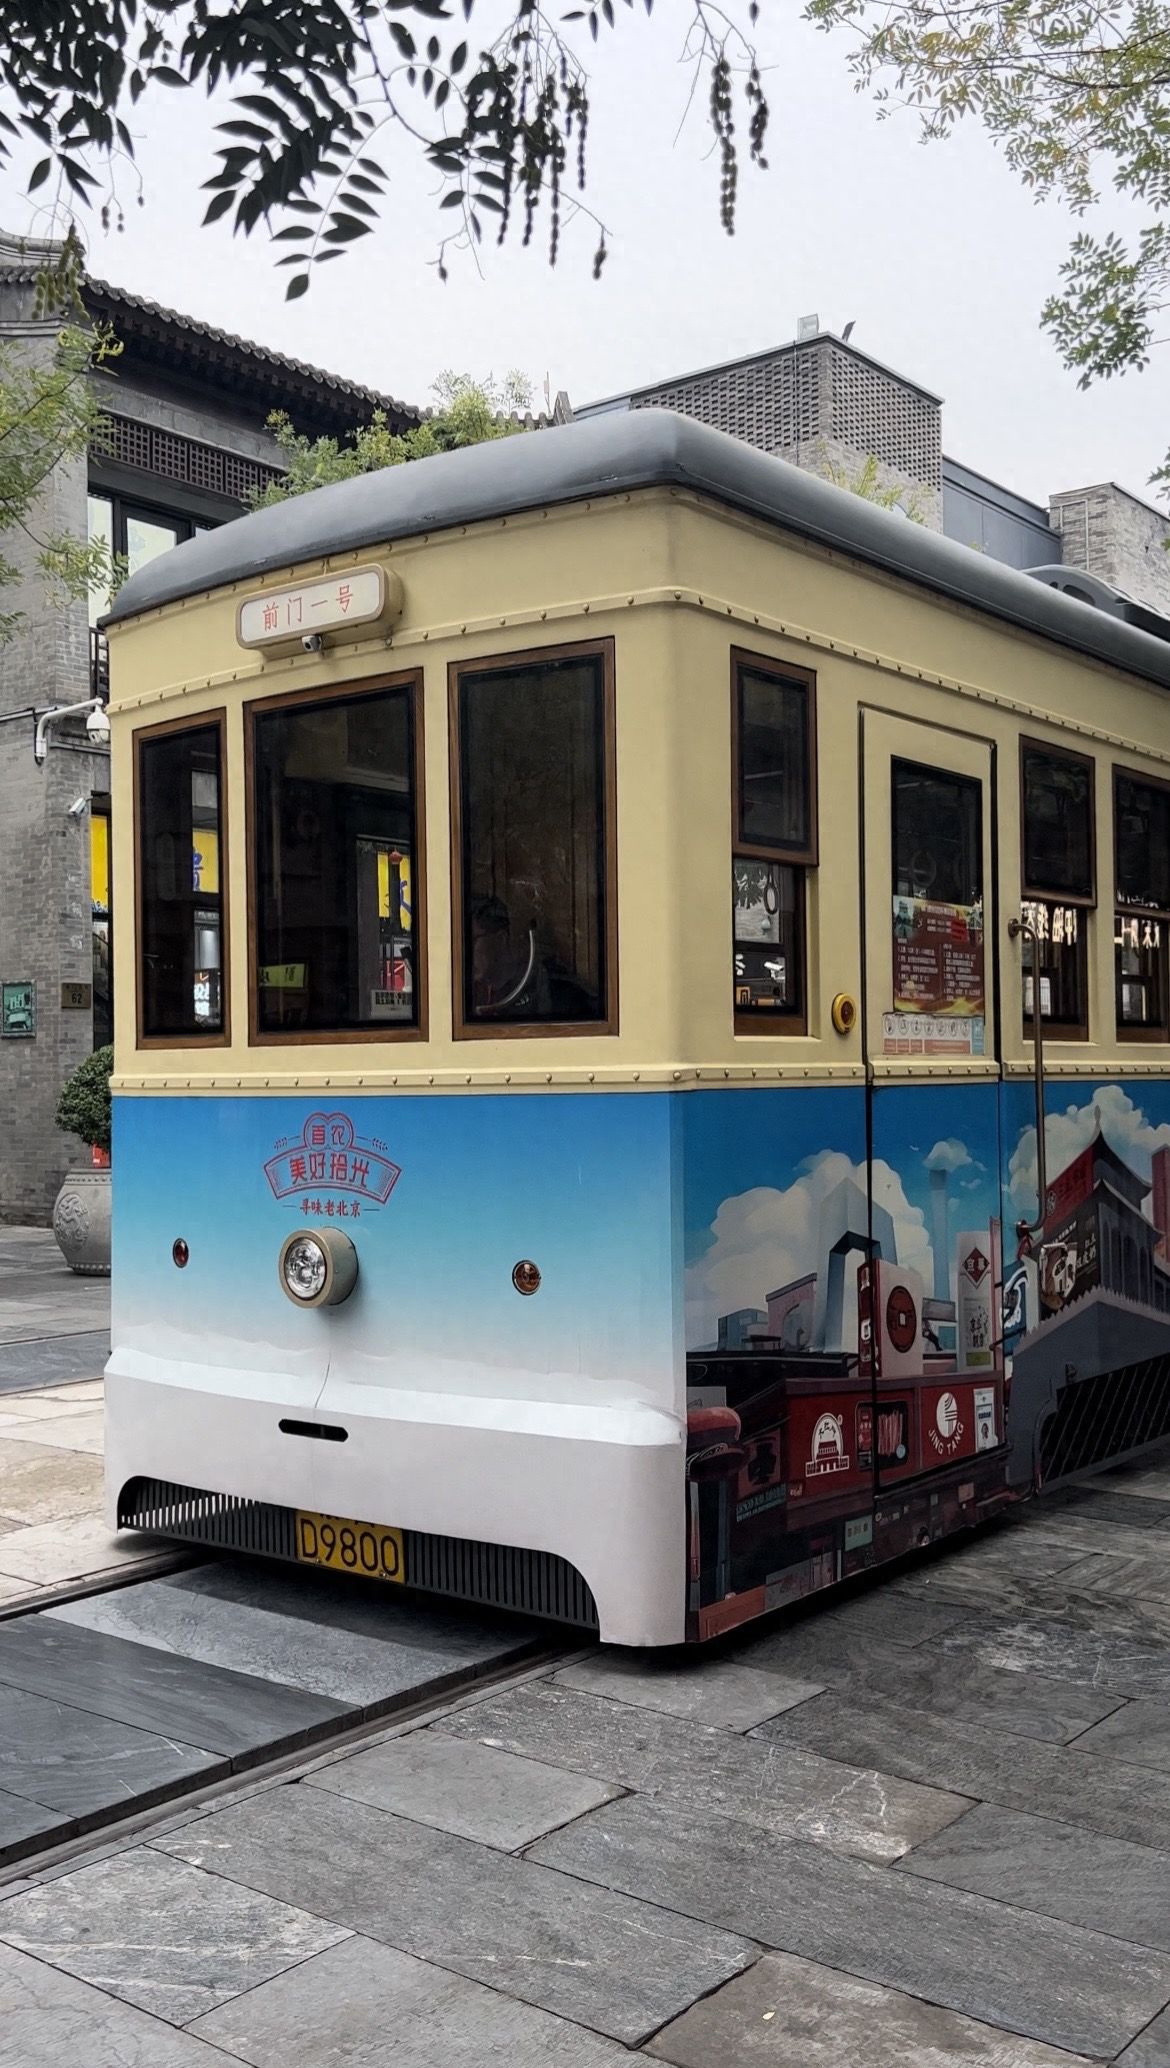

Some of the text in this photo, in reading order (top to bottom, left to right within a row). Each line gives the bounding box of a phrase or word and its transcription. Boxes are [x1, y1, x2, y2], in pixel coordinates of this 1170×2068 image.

[262, 584, 354, 632] 前门一号
[71, 992, 83, 1005] 62
[299, 1197, 362, 1219] 寻味老北京
[928, 1421, 964, 1455] JING TANG
[300, 1518, 400, 1576] D9800
